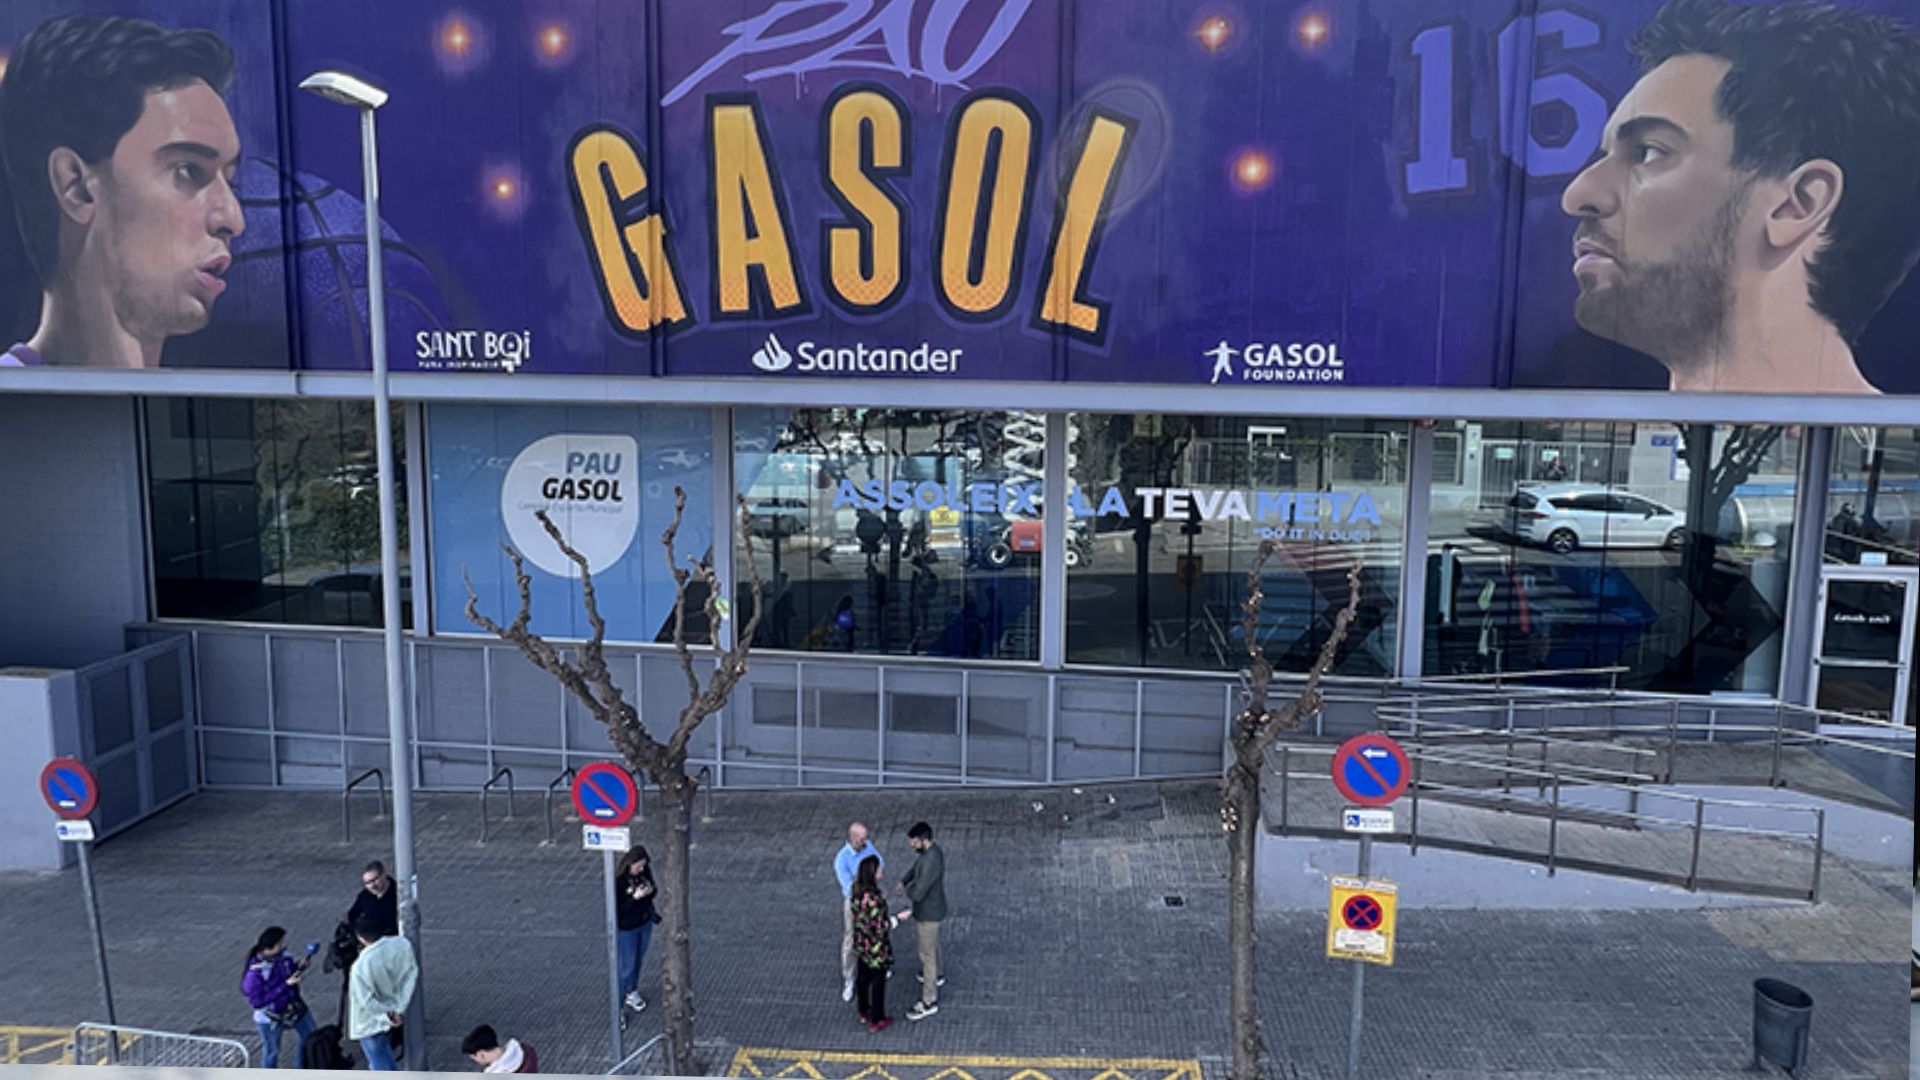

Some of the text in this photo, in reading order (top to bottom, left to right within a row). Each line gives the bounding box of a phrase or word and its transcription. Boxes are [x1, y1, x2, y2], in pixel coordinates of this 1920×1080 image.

[1405, 9, 1609, 194] 16
[569, 87, 1132, 337] GASOL
[416, 331, 476, 358] SANT
[797, 341, 963, 372] Santander
[1243, 343, 1344, 367] GASOL
[1243, 369, 1344, 381] FOUNDATION
[566, 452, 622, 475] PAU
[542, 477, 624, 502] GASOL
[831, 479, 1382, 525] ASSOLEIX LA TEVA META
